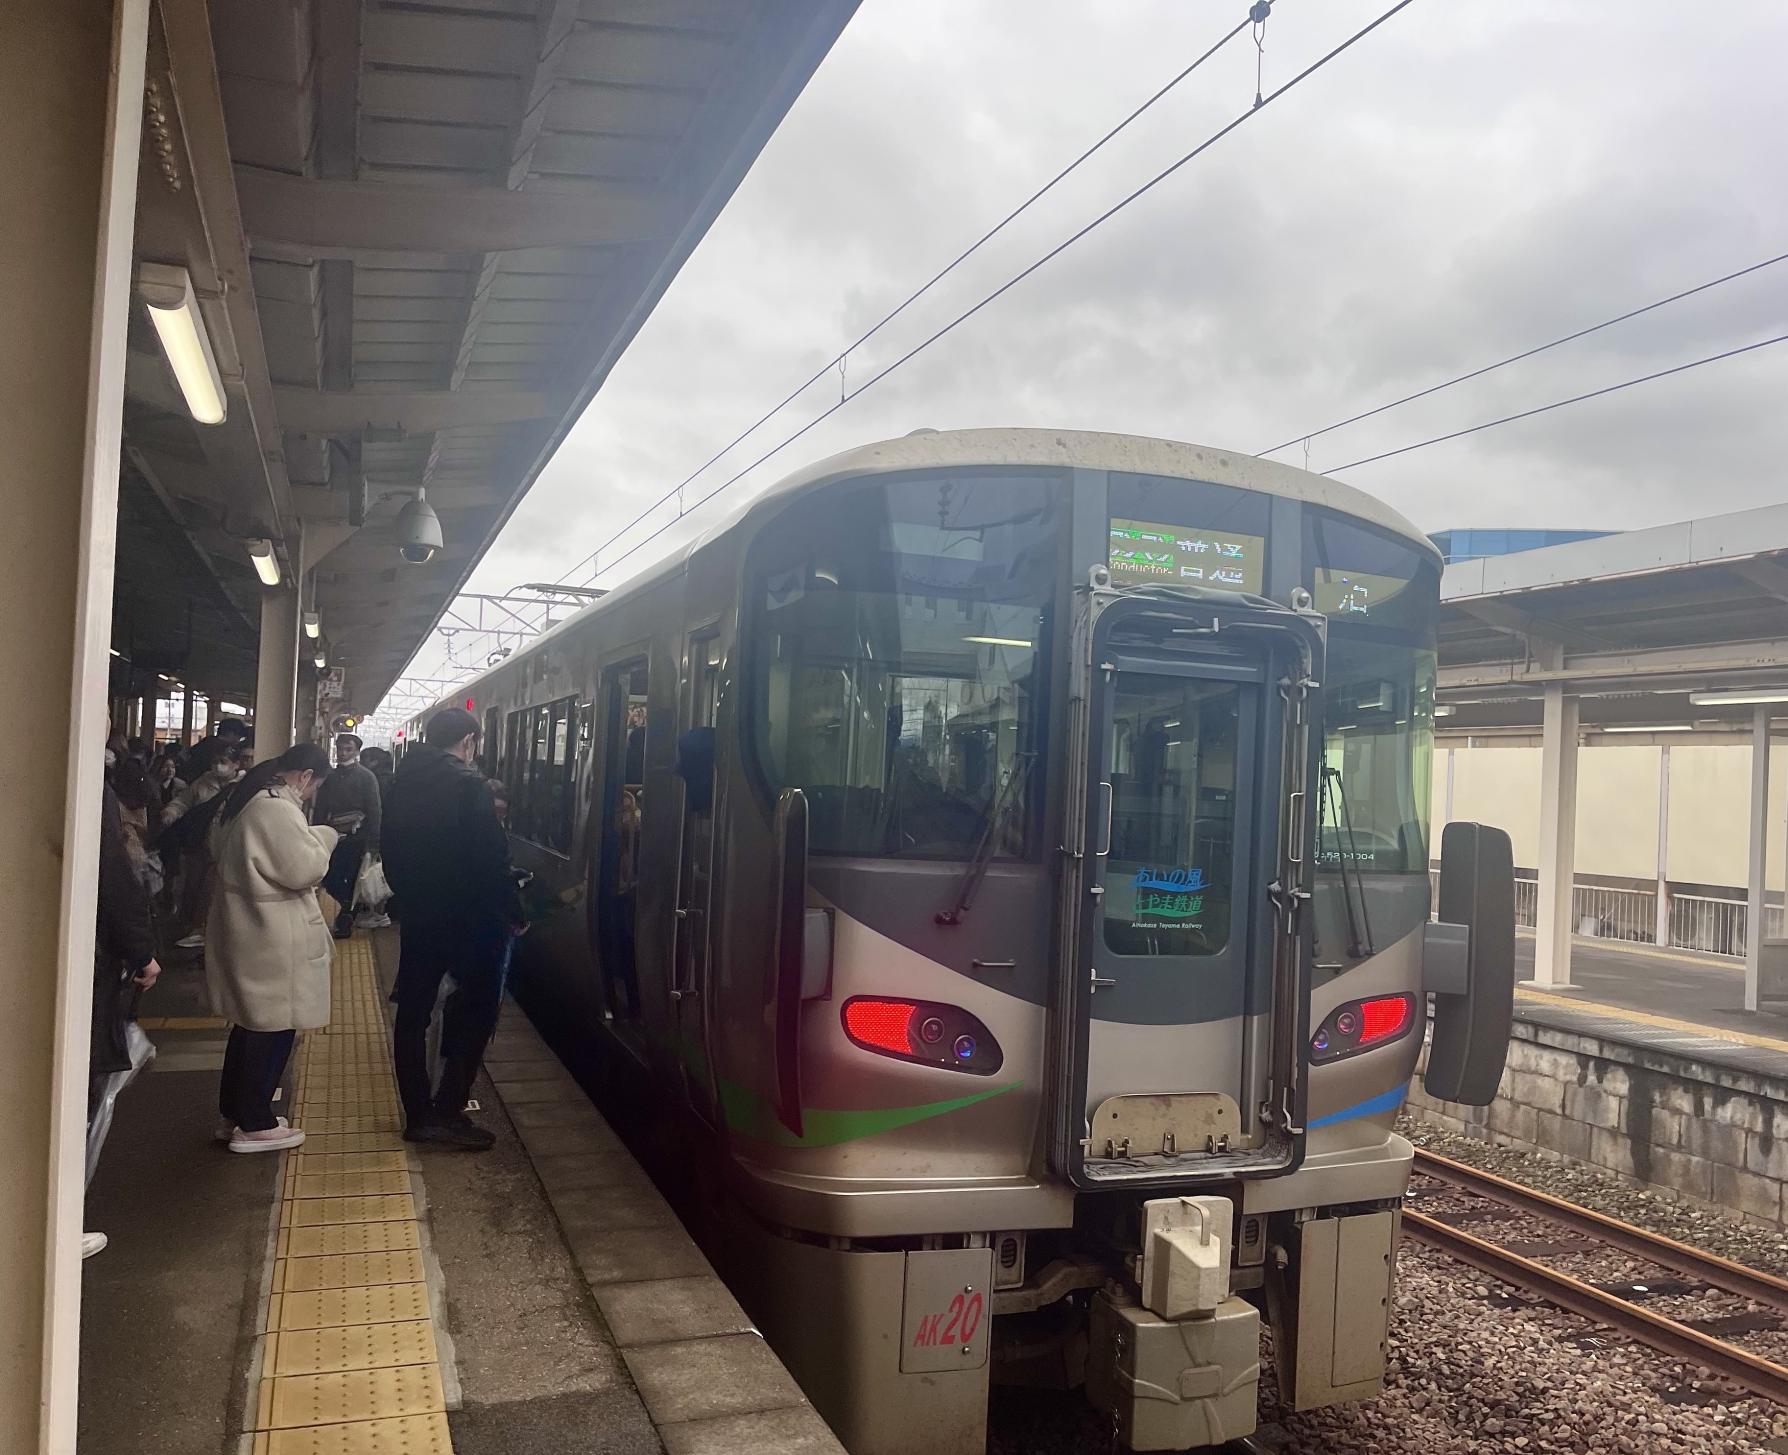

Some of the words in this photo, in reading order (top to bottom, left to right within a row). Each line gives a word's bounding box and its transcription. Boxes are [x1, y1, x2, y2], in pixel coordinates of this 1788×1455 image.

[1135, 867, 1202, 888] あいの風
[912, 1292, 984, 1347] AK20
